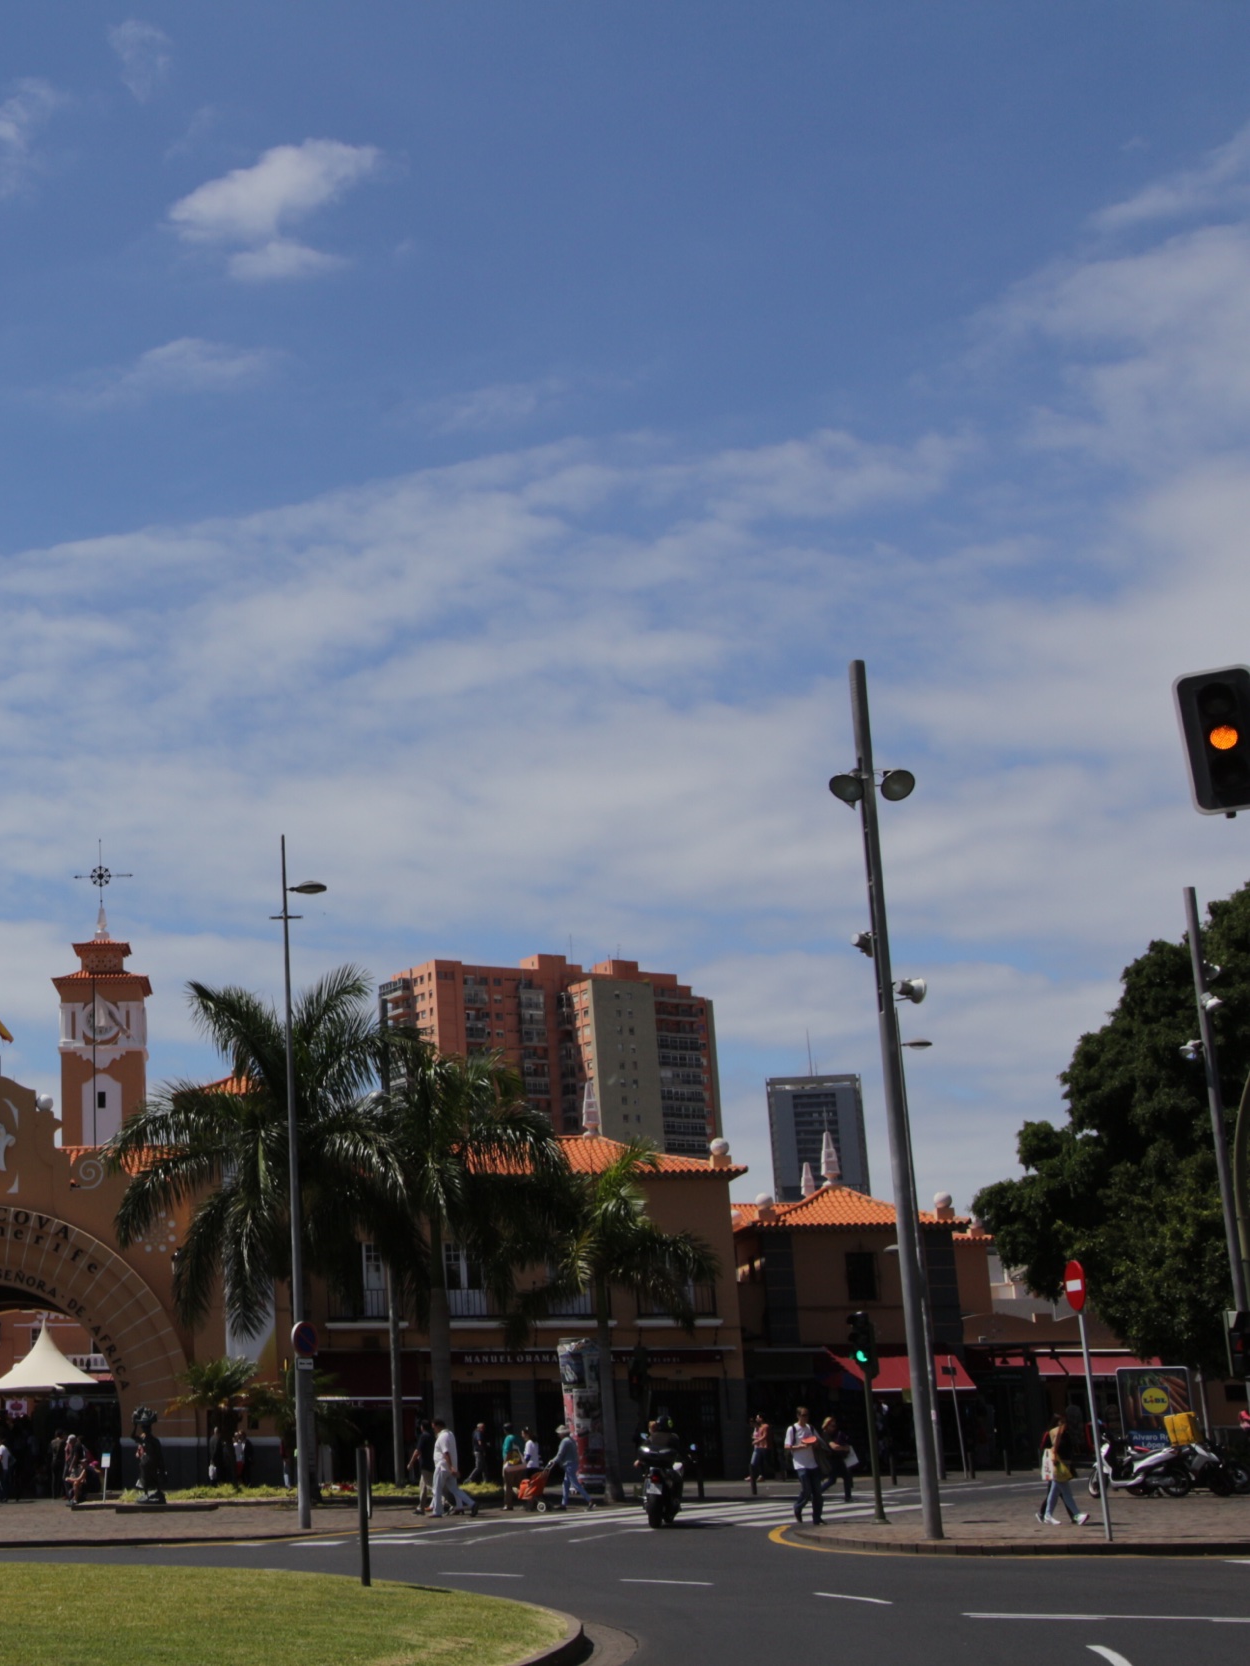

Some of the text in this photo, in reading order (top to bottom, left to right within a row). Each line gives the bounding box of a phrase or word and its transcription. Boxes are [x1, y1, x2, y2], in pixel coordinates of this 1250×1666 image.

[67, 1299, 86, 1317] DE
[91, 1325, 130, 1391] AFRICA
[464, 1355, 513, 1364] MANUEL
[517, 1354, 558, 1363] ORAMA
[1141, 1441, 1165, 1450] López
